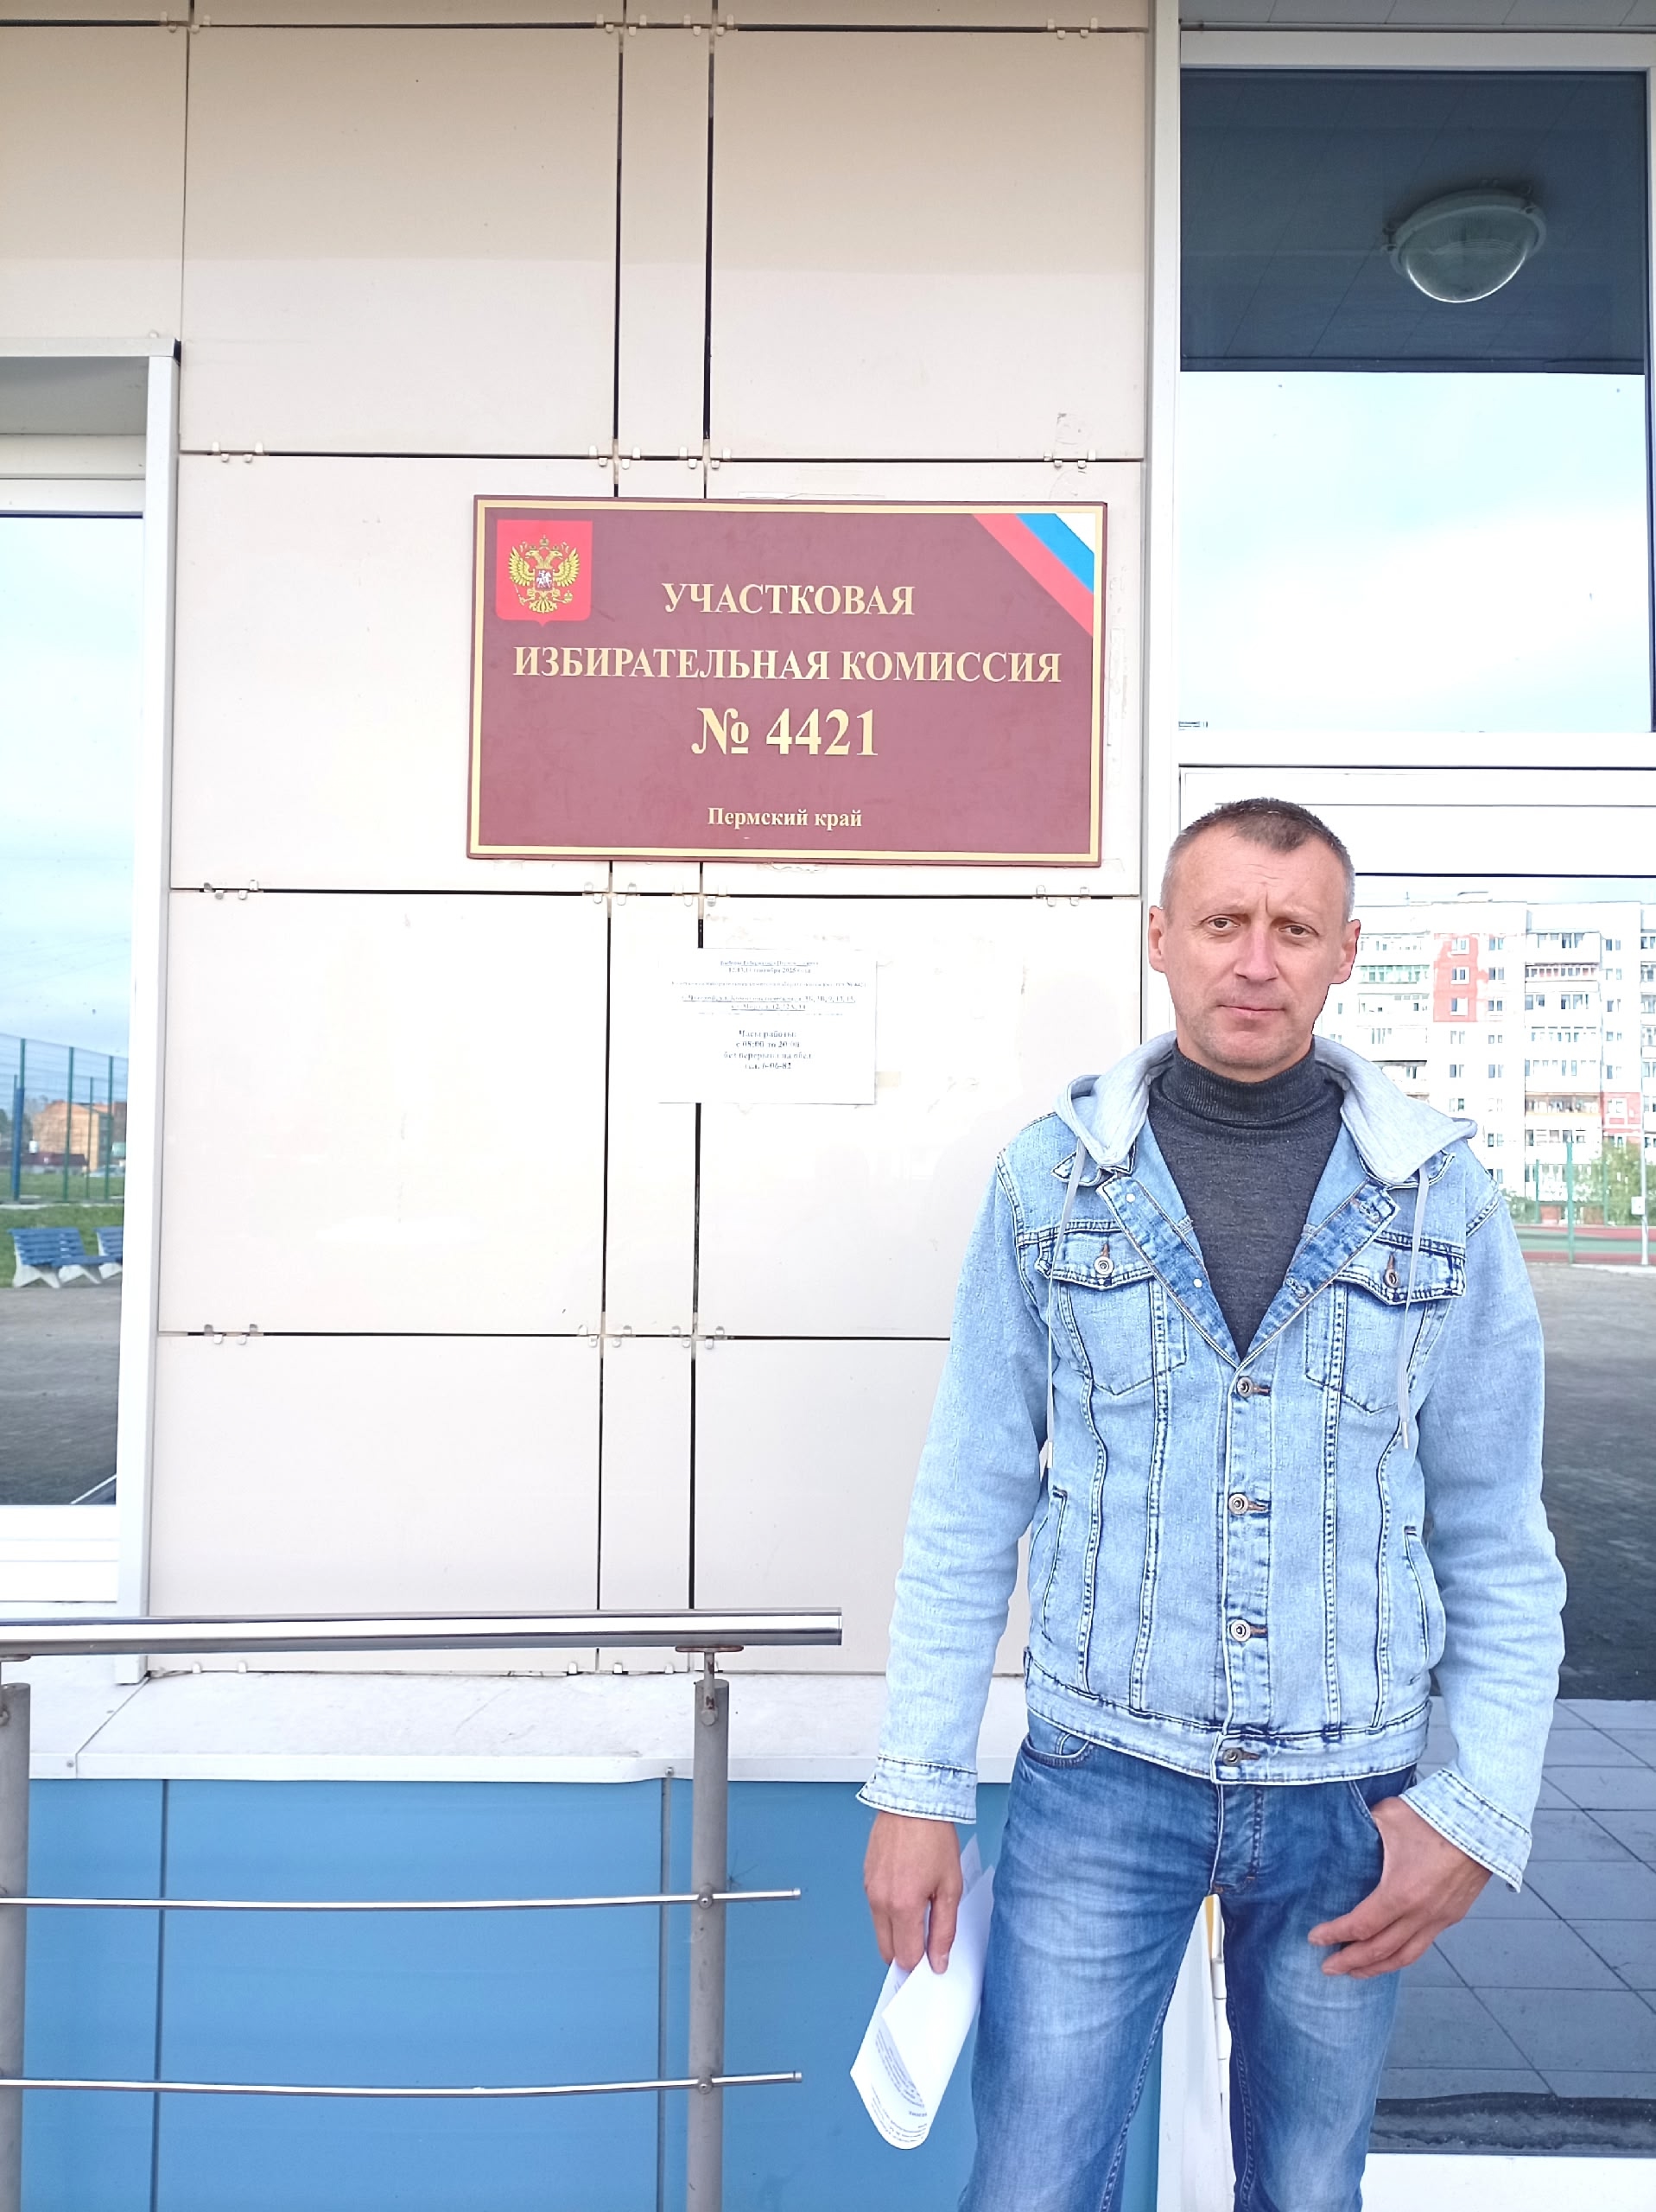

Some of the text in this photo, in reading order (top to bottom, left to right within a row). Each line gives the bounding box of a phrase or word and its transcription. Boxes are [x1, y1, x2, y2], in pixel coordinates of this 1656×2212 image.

[662, 582, 916, 615] УЧАСТКОВАЯ
[513, 645, 1063, 683] ИЗБИРАТЕЛЬНАЯ КОМИССИЯ
[691, 707, 879, 756] № 4421
[707, 807, 863, 830] Пермский край
